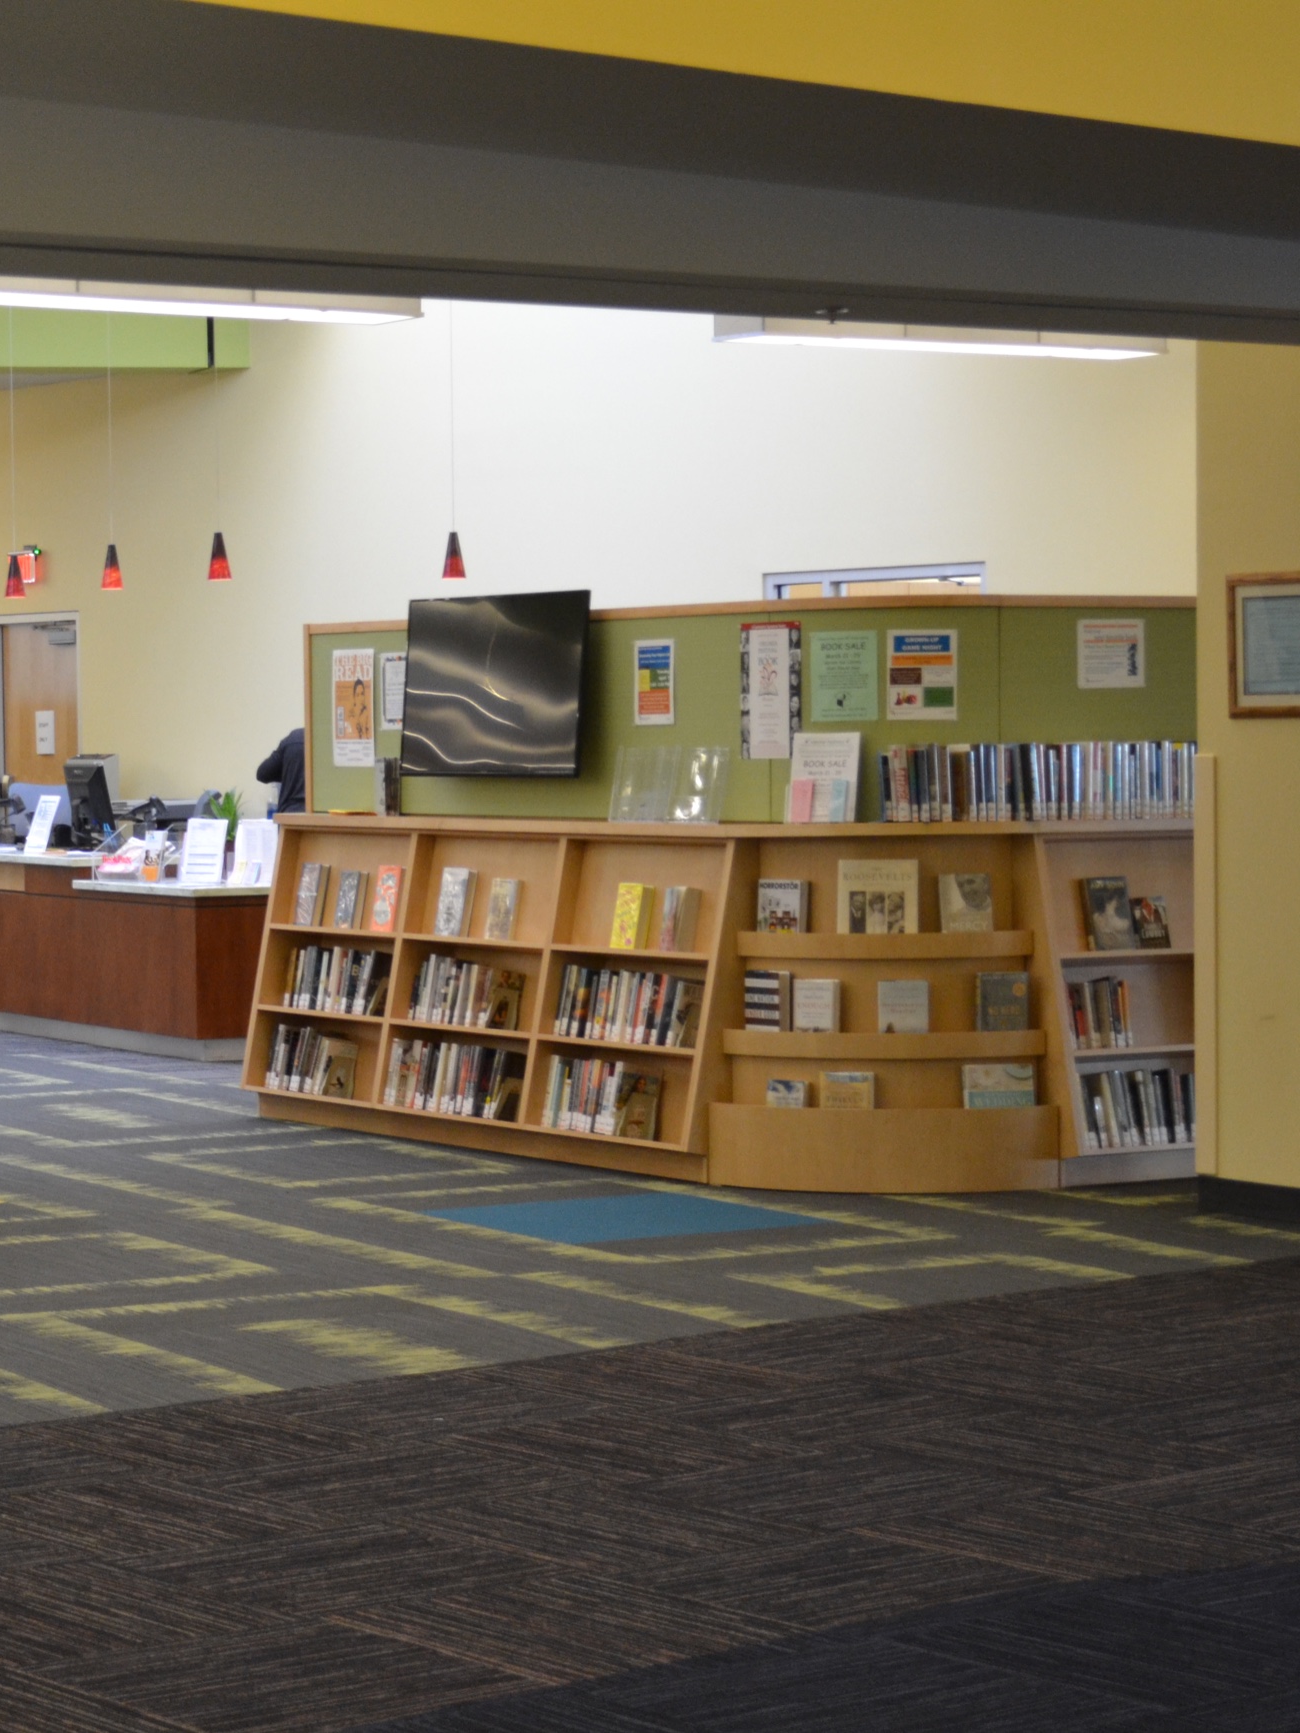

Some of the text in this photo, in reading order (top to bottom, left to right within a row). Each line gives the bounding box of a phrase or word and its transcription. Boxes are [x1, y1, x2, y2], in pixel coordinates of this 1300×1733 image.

[820, 641, 866, 652] BOOK SALE
[335, 665, 371, 680] READ
[803, 760, 847, 768] BOOK SALE
[842, 872, 913, 882] ROOSEVELTS
[950, 921, 990, 931] MERCY
